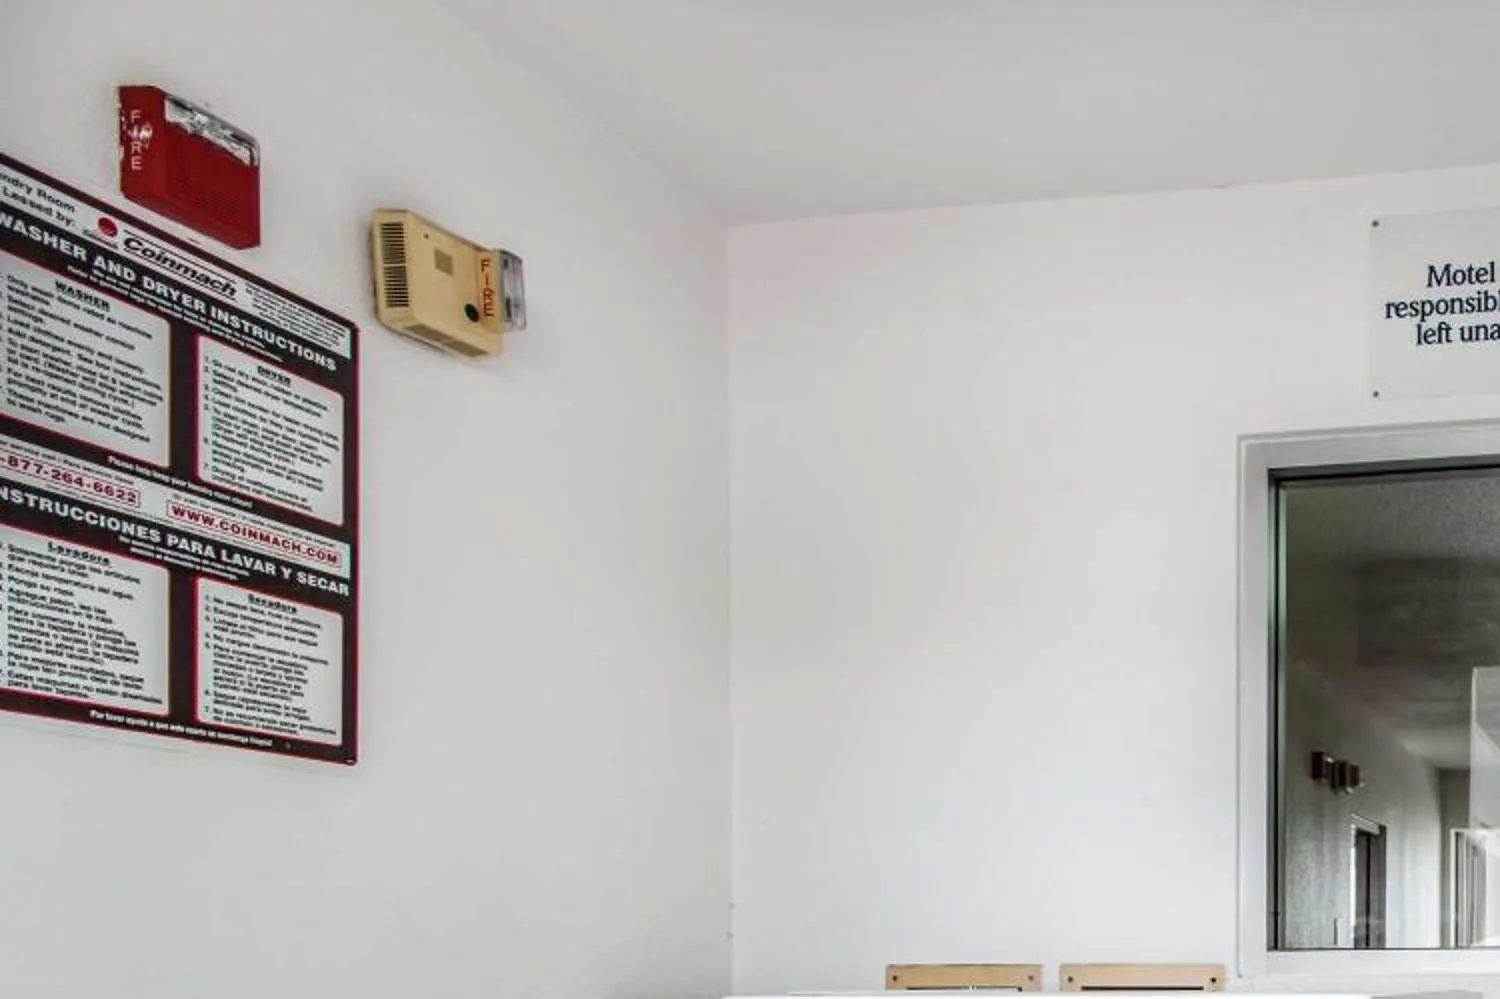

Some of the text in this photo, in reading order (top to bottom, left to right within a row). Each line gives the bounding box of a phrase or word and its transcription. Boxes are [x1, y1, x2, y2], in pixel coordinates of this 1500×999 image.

[3, 186, 53, 217] Leased
[37, 188, 76, 212] Room
[123, 235, 238, 300] Coinmach
[480, 258, 495, 317] FIRE
[1426, 261, 1495, 288] Motel
[0, 211, 88, 264] WASHER
[94, 254, 137, 283] AND
[143, 276, 207, 315] DRYER
[211, 305, 337, 371] INSTRUCTIONS
[56, 280, 112, 310] WASHER
[1415, 321, 1453, 346] left
[172, 504, 338, 563] WWW.COINMACH.COM
[167, 532, 215, 559] PARA
[221, 547, 276, 577] LAVAR
[281, 564, 293, 580] Y
[297, 571, 350, 597] SECAR
